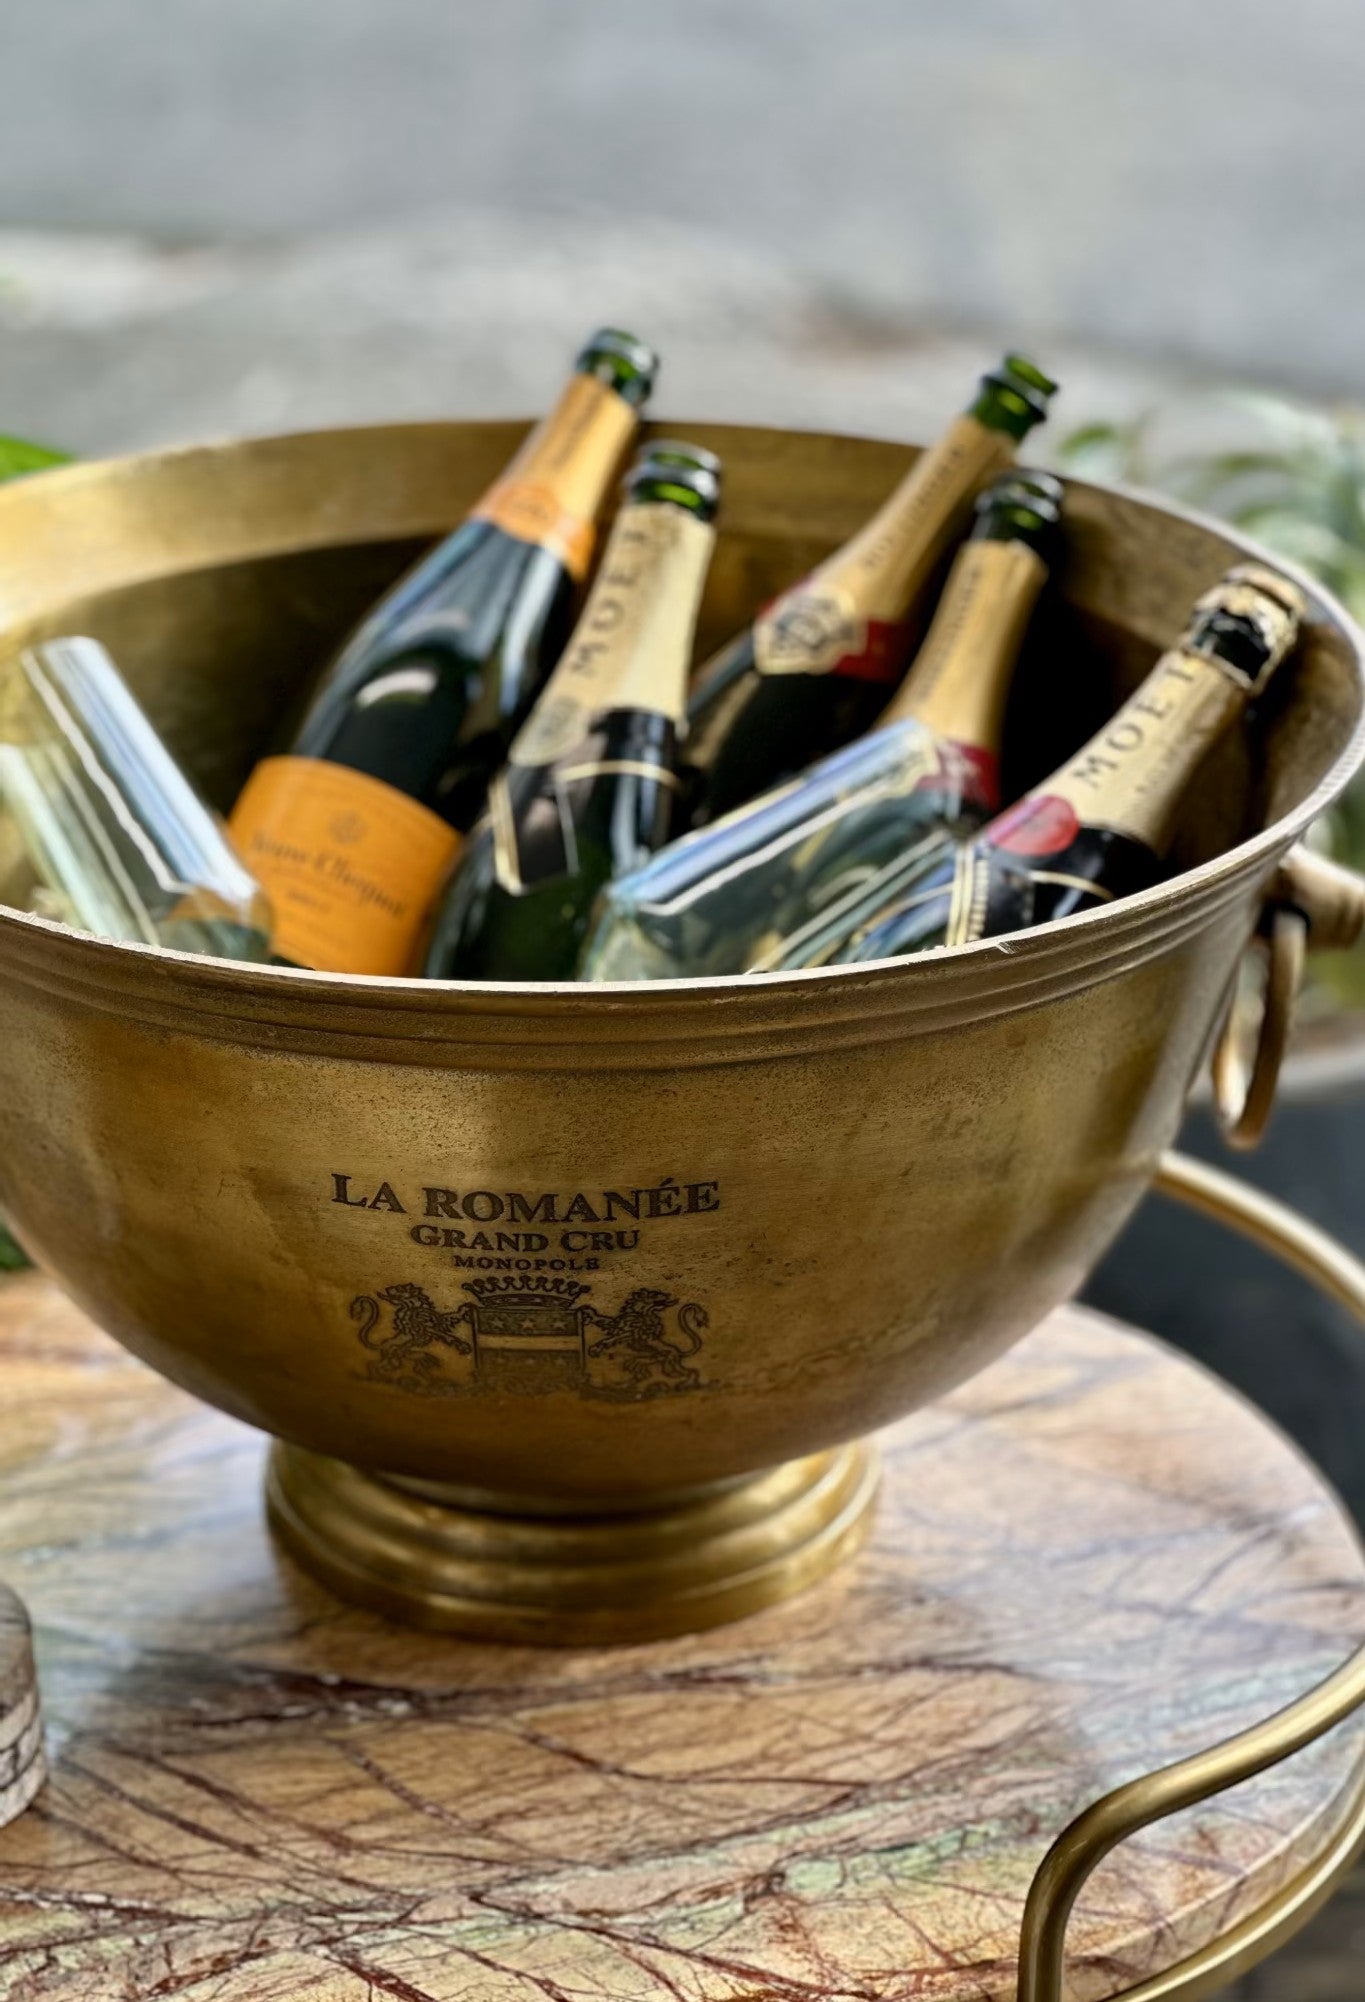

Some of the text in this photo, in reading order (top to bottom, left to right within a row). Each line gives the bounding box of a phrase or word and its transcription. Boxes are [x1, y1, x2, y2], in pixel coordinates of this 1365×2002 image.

[331, 1173, 721, 1223] LA ROMANÉE
[410, 1224, 641, 1252] GRAND CRU
[453, 1254, 601, 1271] MONOPOLE
